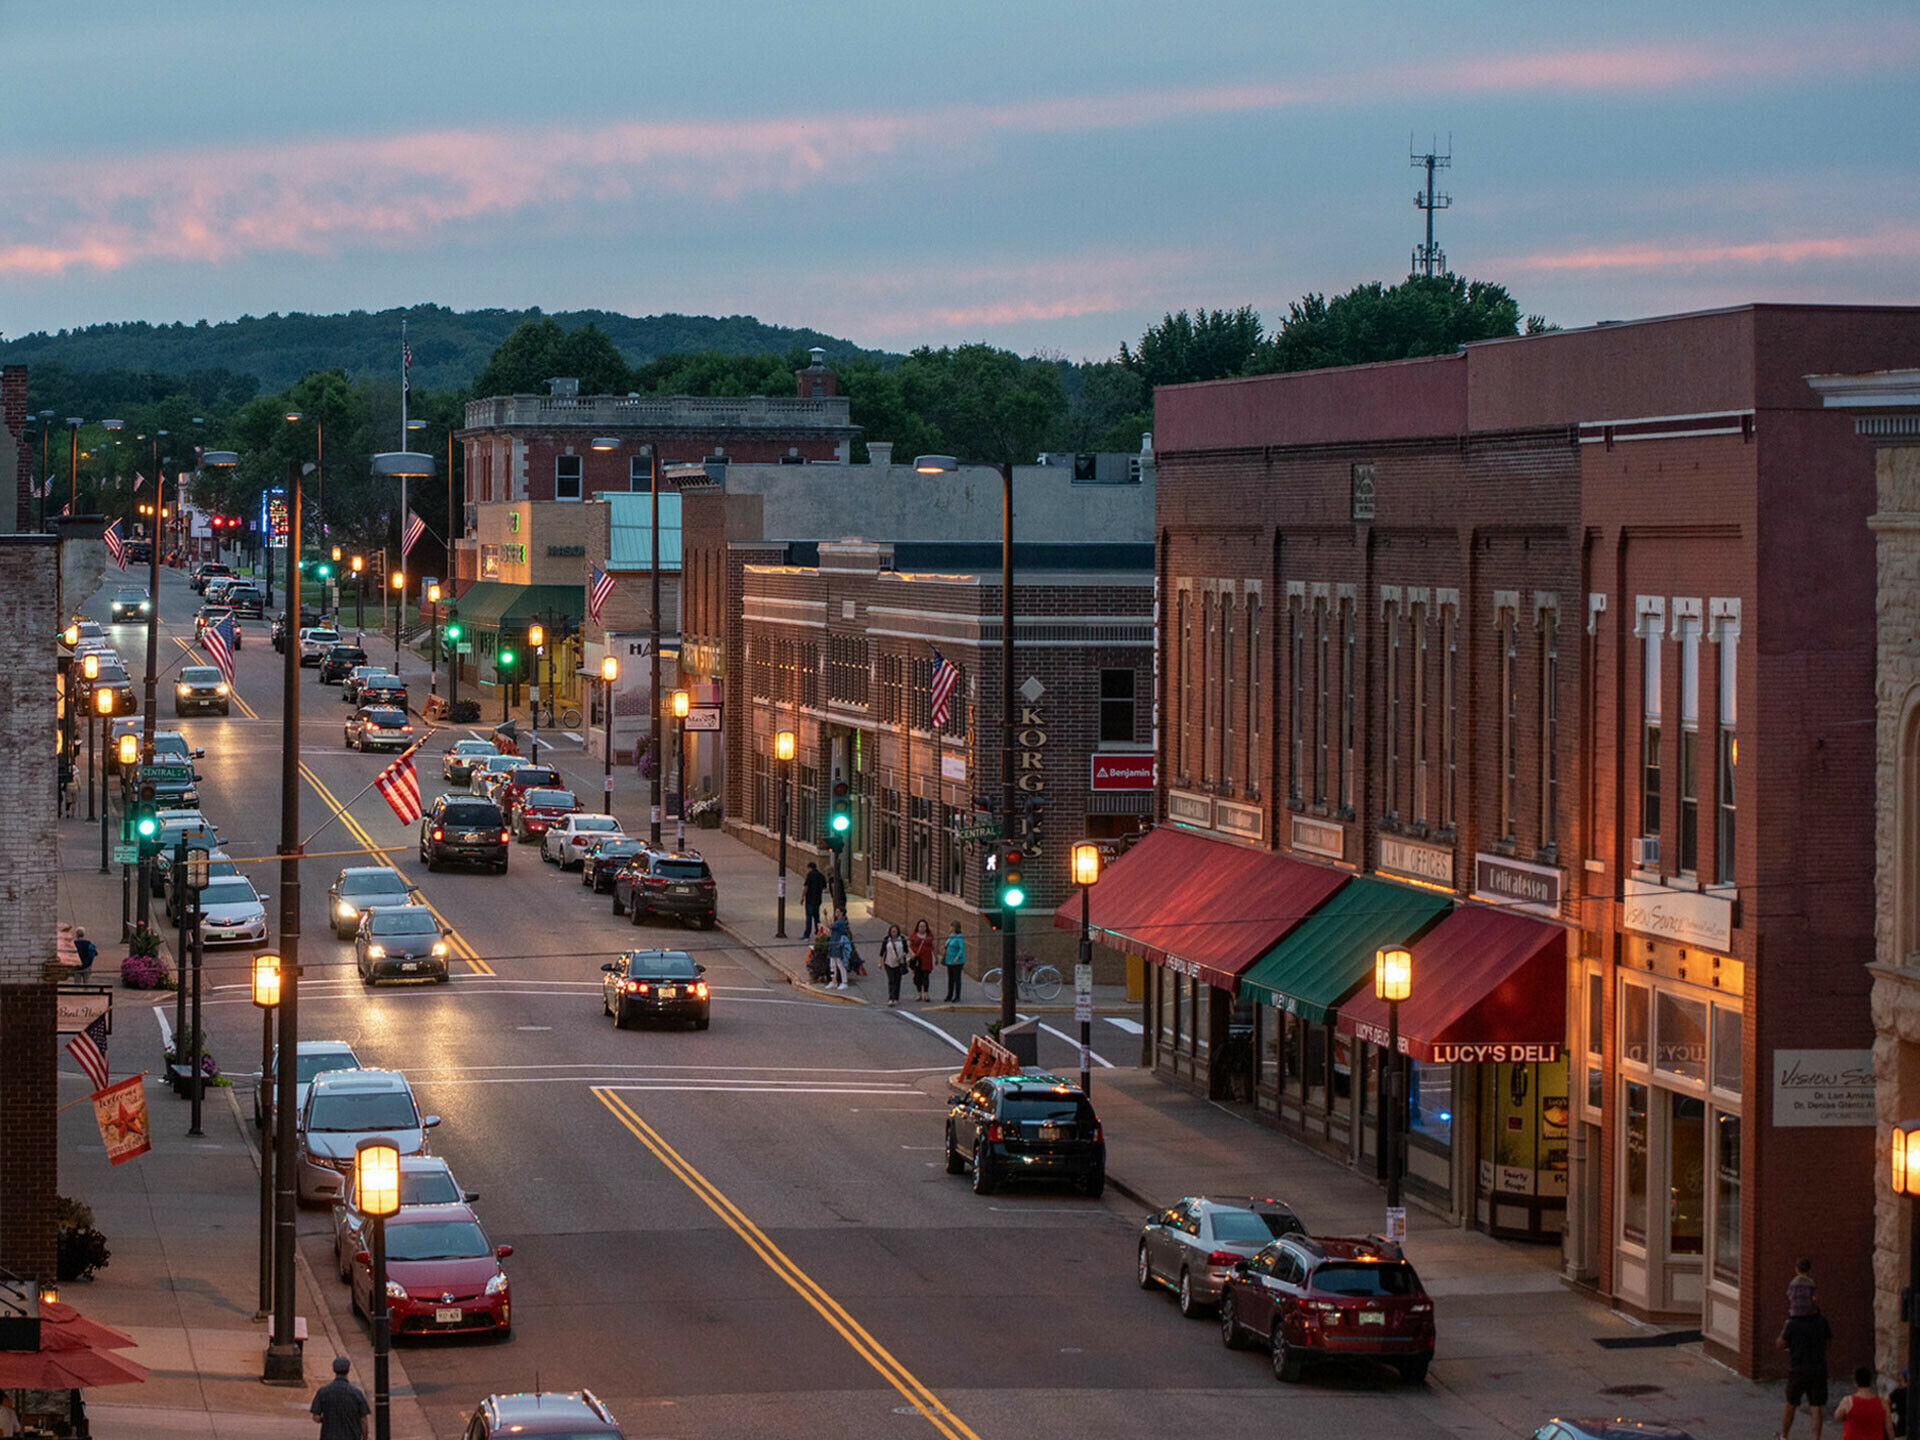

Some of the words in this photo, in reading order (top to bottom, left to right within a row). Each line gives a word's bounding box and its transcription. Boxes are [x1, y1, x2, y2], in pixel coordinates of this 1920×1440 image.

[141, 768, 176, 778] CENTRAL
[1109, 767, 1151, 778] Benjamin
[959, 827, 997, 840] CENTRAL
[1385, 842, 1405, 869] LAW
[1410, 848, 1448, 878] OFFICES
[1489, 867, 1548, 901] Delicatessen
[1433, 1045, 1506, 1063] LUCY'S
[1511, 1045, 1555, 1063] DELI
